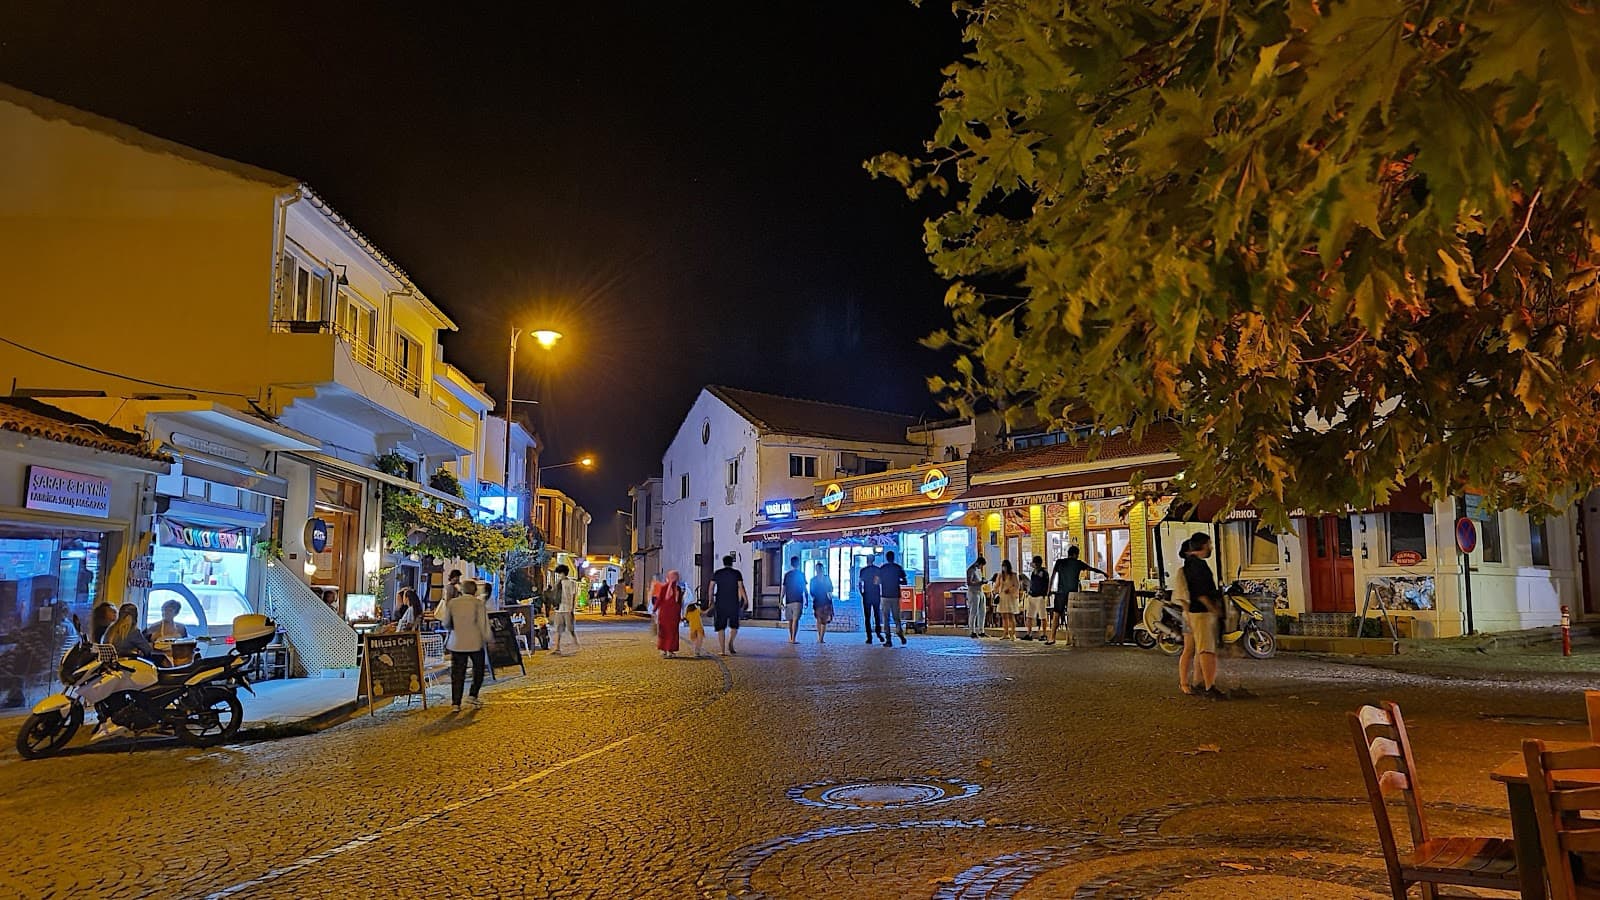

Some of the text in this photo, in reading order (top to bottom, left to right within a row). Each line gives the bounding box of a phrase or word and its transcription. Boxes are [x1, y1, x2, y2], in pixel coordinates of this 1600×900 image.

[67, 478, 76, 492] &
[991, 498, 1008, 508] USTA
[1062, 492, 1072, 501] EV
[1083, 489, 1105, 499] FIRIN
[174, 526, 244, 550] DONDURMA
